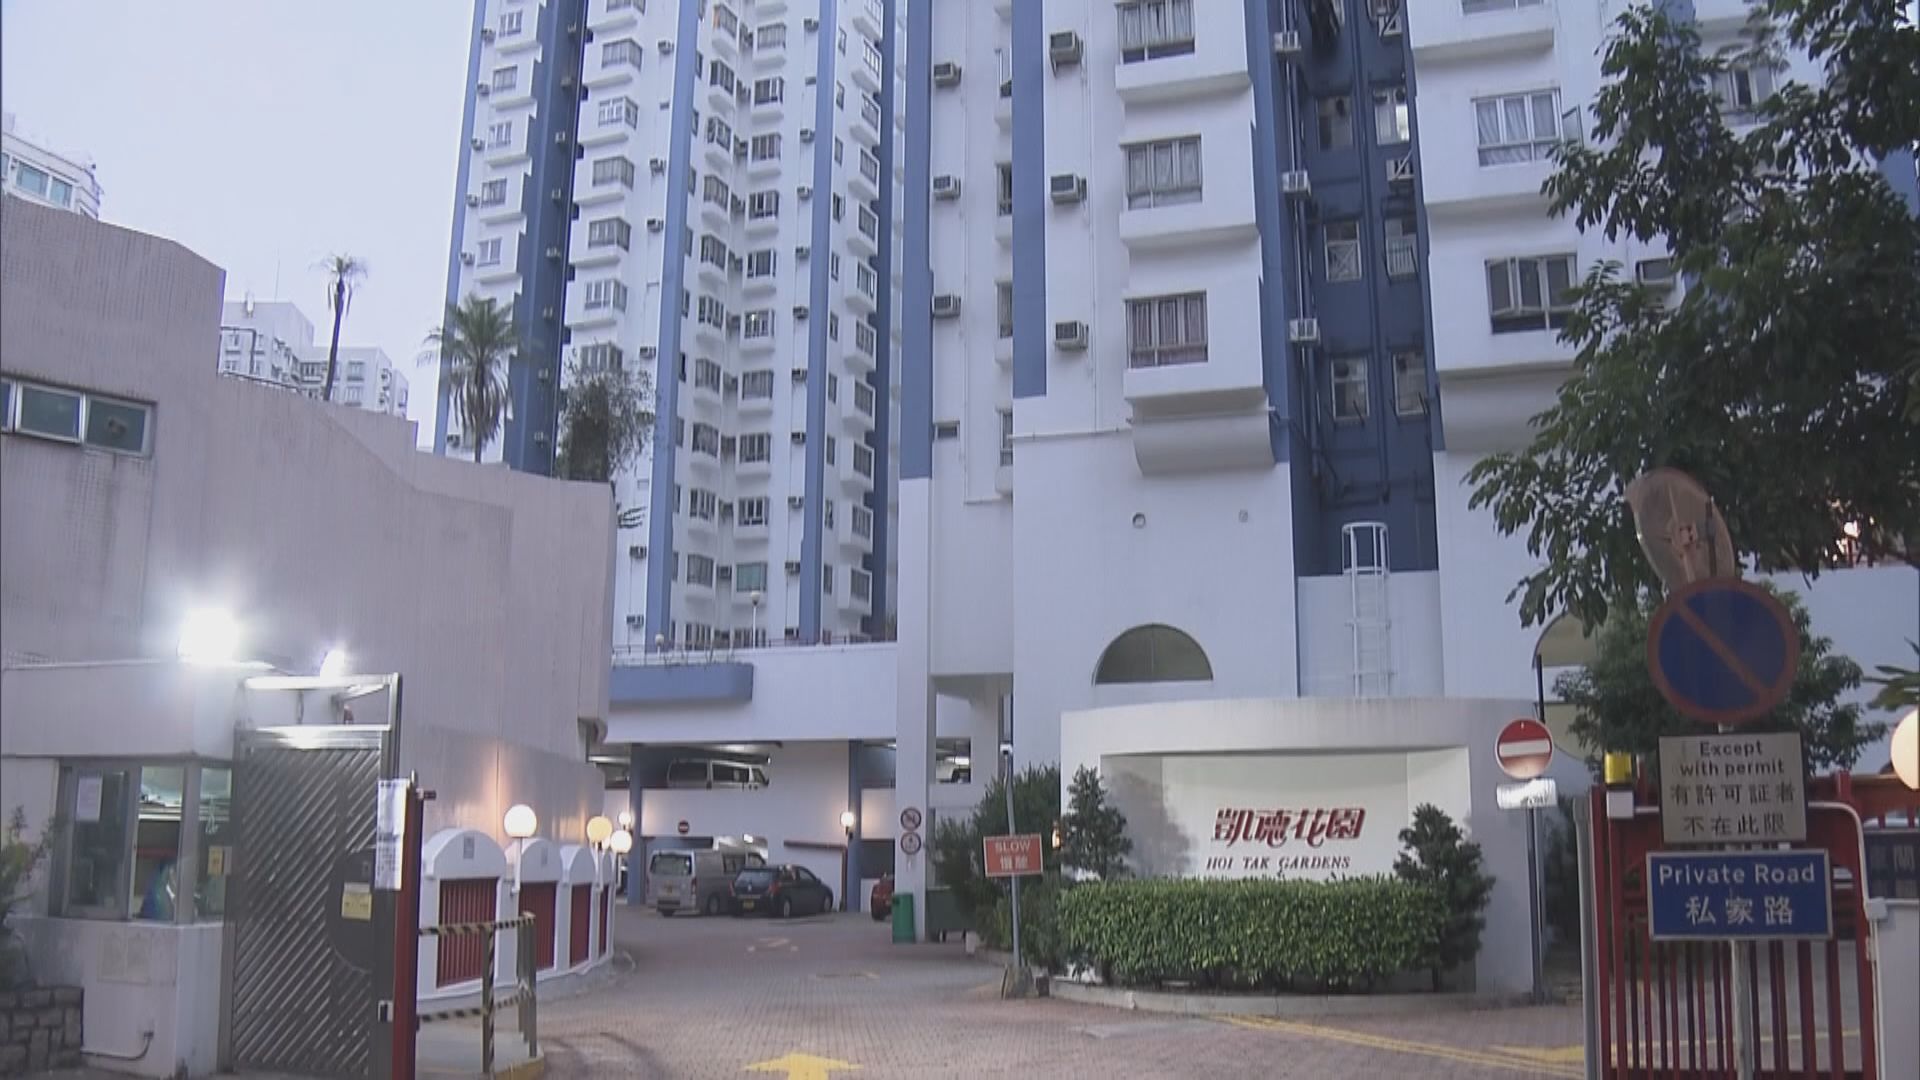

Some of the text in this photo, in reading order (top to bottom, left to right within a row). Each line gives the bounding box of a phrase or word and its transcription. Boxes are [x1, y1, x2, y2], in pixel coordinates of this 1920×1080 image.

[1700, 740, 1762, 757] Except
[1680, 758, 1784, 778] with permit
[1683, 812, 1785, 836] 不在此限
[995, 840, 1031, 854] SLOW
[1206, 856, 1351, 870] HOI TAK GARDENS
[1659, 862, 1815, 886] Private Road
[1685, 895, 1793, 926] 私家路
